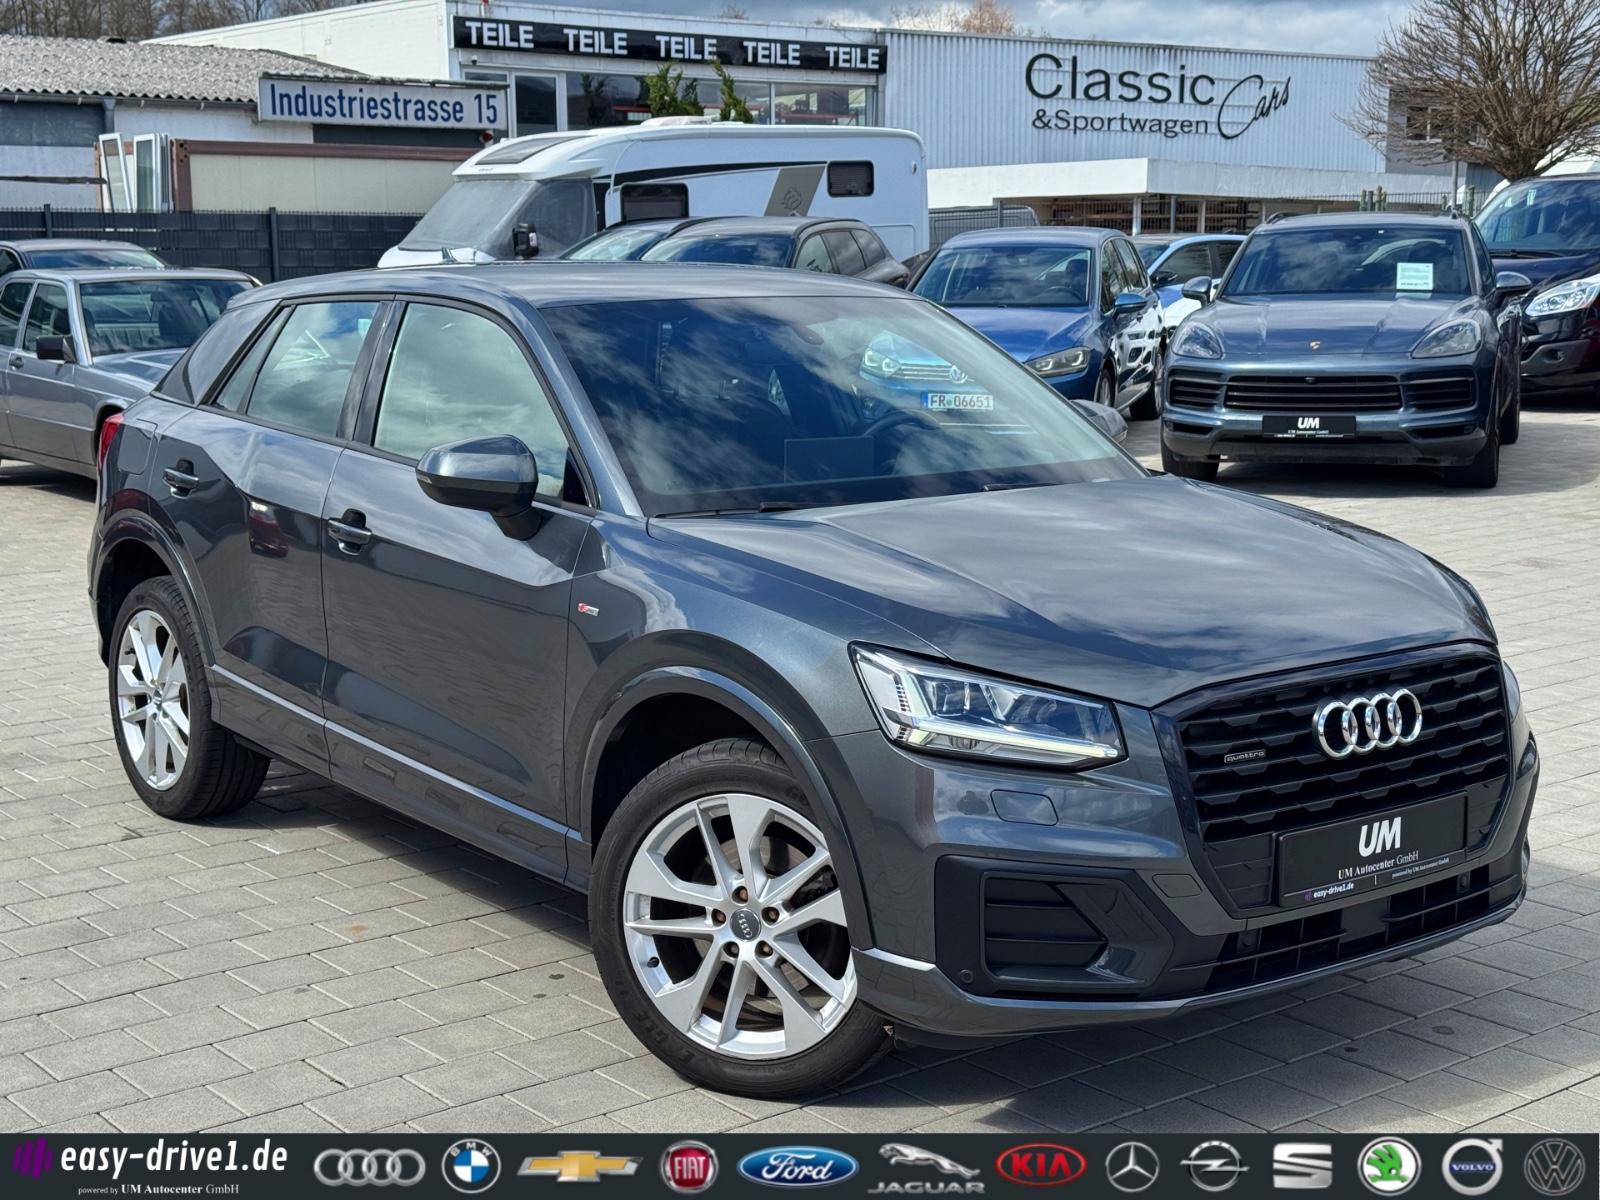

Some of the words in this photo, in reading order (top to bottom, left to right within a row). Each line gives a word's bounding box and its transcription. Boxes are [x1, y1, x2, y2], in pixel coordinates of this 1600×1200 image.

[465, 20, 534, 49] TEILE
[563, 28, 628, 55] TEILE
[655, 35, 717, 60] TEILE
[743, 40, 801, 66] TEILE
[825, 46, 880, 70] TEILE
[270, 83, 464, 123] Industriestrasse
[473, 93, 498, 124] 15
[1025, 53, 1215, 105] Classic
[1217, 74, 1292, 140] Cars
[1032, 108, 1208, 138] &Sportwagen
[930, 394, 946, 407] FR
[1297, 417, 1320, 429] UM
[1226, 751, 1265, 762] quattro
[1358, 816, 1402, 857] UM
[1338, 868, 1353, 880] UM
[1354, 858, 1395, 876] Autocenter
[1396, 850, 1419, 865] GmbH
[1313, 882, 1354, 899] easy-drive1.de
